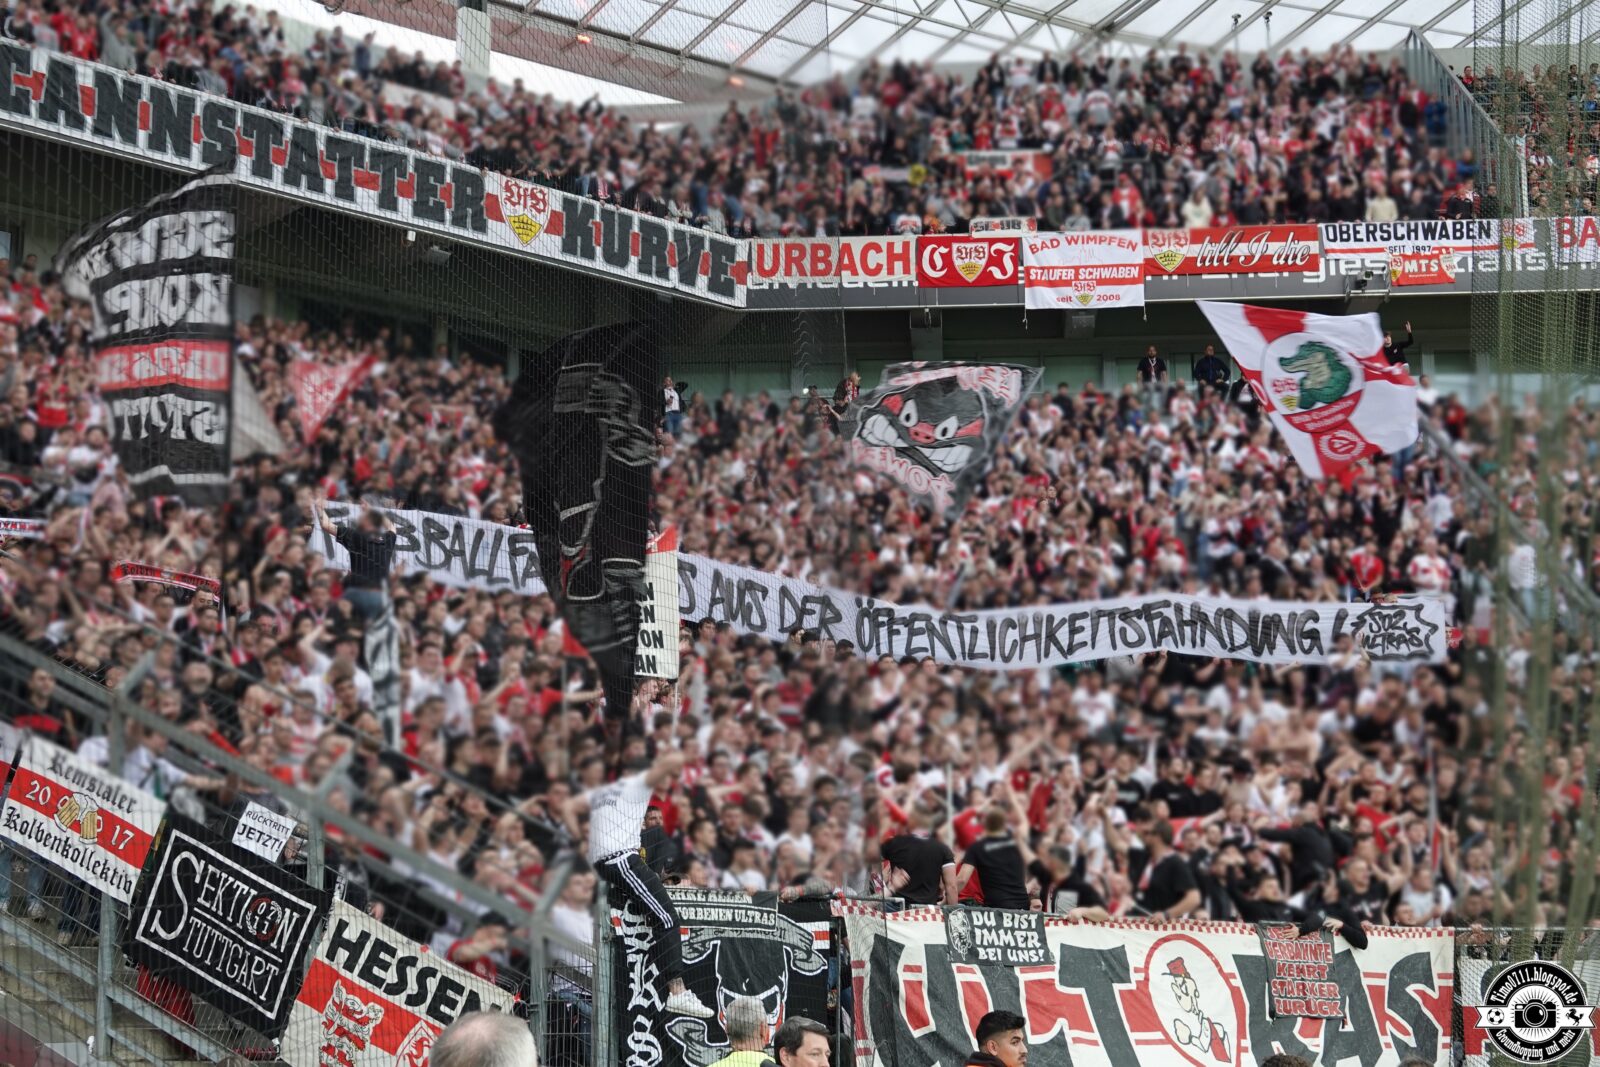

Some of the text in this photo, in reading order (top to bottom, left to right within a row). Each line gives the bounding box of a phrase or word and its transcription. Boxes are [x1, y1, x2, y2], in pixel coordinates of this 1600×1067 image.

[0, 43, 487, 234] CANNSTATTER
[562, 196, 738, 298] KURVE
[1325, 220, 1492, 244] OBERSCHWABEN
[1029, 234, 1139, 256] BAD WIMPFEN
[1196, 230, 1244, 268] till
[1272, 231, 1311, 266] die
[1388, 245, 1432, 255] SEIT 1997
[756, 241, 911, 278] URBACH
[1404, 259, 1439, 273] MTS
[1029, 267, 1076, 281] STAUFER
[1079, 265, 1140, 280] SCHWABEN
[1056, 294, 1121, 303] seit 2008
[708, 568, 769, 633] AUS
[779, 584, 843, 649] DER
[855, 596, 1324, 664] ÖFFENTLICHKEITSFAHNDUNG
[47, 748, 139, 815] Remstaler
[25, 779, 135, 851] 20 17
[245, 809, 291, 835] RÜCKTRITT
[237, 823, 285, 854] JETZT!
[2, 805, 133, 895] Kolbenkollektiv
[734, 909, 776, 927] ULTRAS
[971, 911, 1039, 929] DU BIST
[974, 928, 1042, 949] IMMER
[976, 947, 1045, 963] BEI UNS!
[1264, 939, 1333, 963] VERBANNTE
[1276, 961, 1329, 981] KEHRT
[1271, 979, 1341, 999] STÄRKER
[1274, 997, 1344, 1017] ZURÜCK
